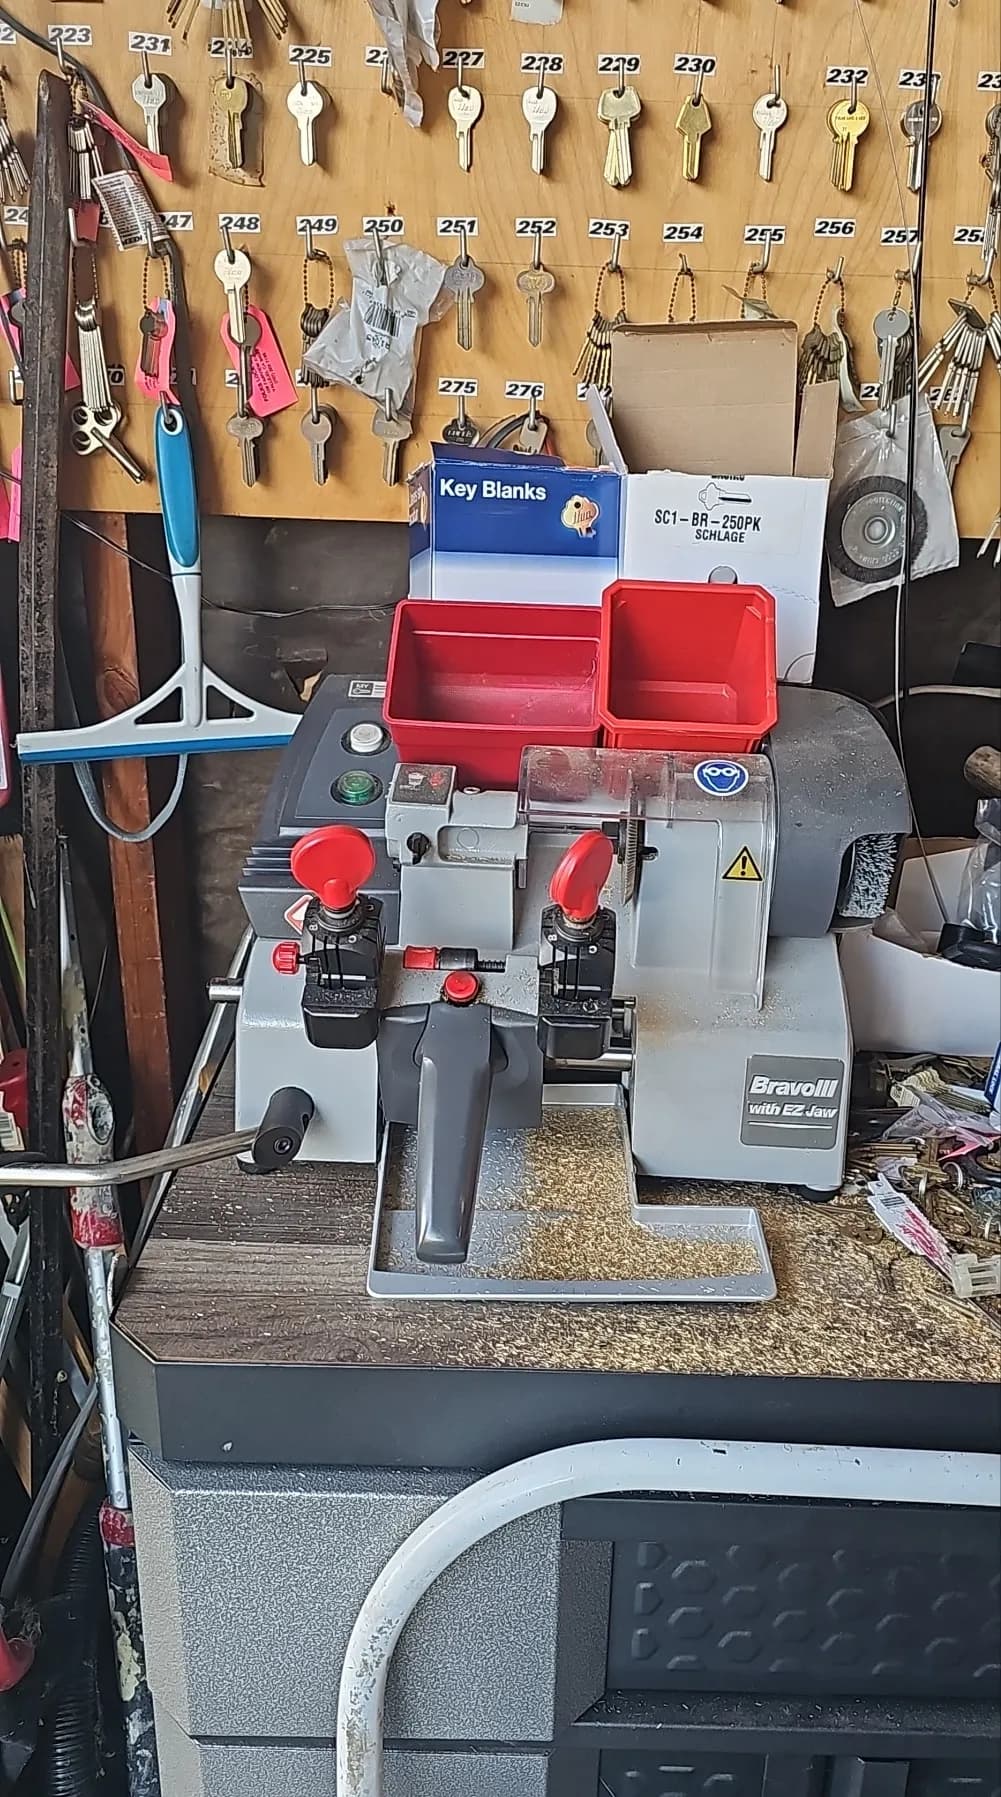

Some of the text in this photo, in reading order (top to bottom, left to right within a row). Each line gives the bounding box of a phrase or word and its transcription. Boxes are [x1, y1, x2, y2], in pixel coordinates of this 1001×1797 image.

[49, 27, 91, 43] 223
[131, 34, 171, 52] 231
[289, 47, 331, 64] 225
[443, 51, 483, 66] 227
[521, 55, 563, 71] 228
[598, 56, 640, 72] 229
[674, 57, 716, 73] 230
[826, 68, 869, 84] 232
[899, 72, 940, 88] 23
[977, 73, 1001, 89] 23
[4, 208, 29, 223] 24
[160, 213, 192, 228] 47
[222, 216, 259, 231] 248
[298, 218, 337, 233] 249
[364, 219, 404, 233] 250
[439, 219, 476, 233] 251
[516, 220, 556, 234] 252
[589, 221, 629, 237] 253
[815, 221, 854, 235] 256
[664, 226, 703, 240] 254
[745, 227, 785, 242] 255
[881, 229, 919, 244] 257
[953, 228, 985, 243] 25
[439, 379, 477, 394] 275
[505, 383, 544, 398] 276
[440, 478, 547, 502] Key Blanks
[695, 528, 746, 543] SCHLAGE
[748, 1101, 838, 1119] with EZ Jaw
